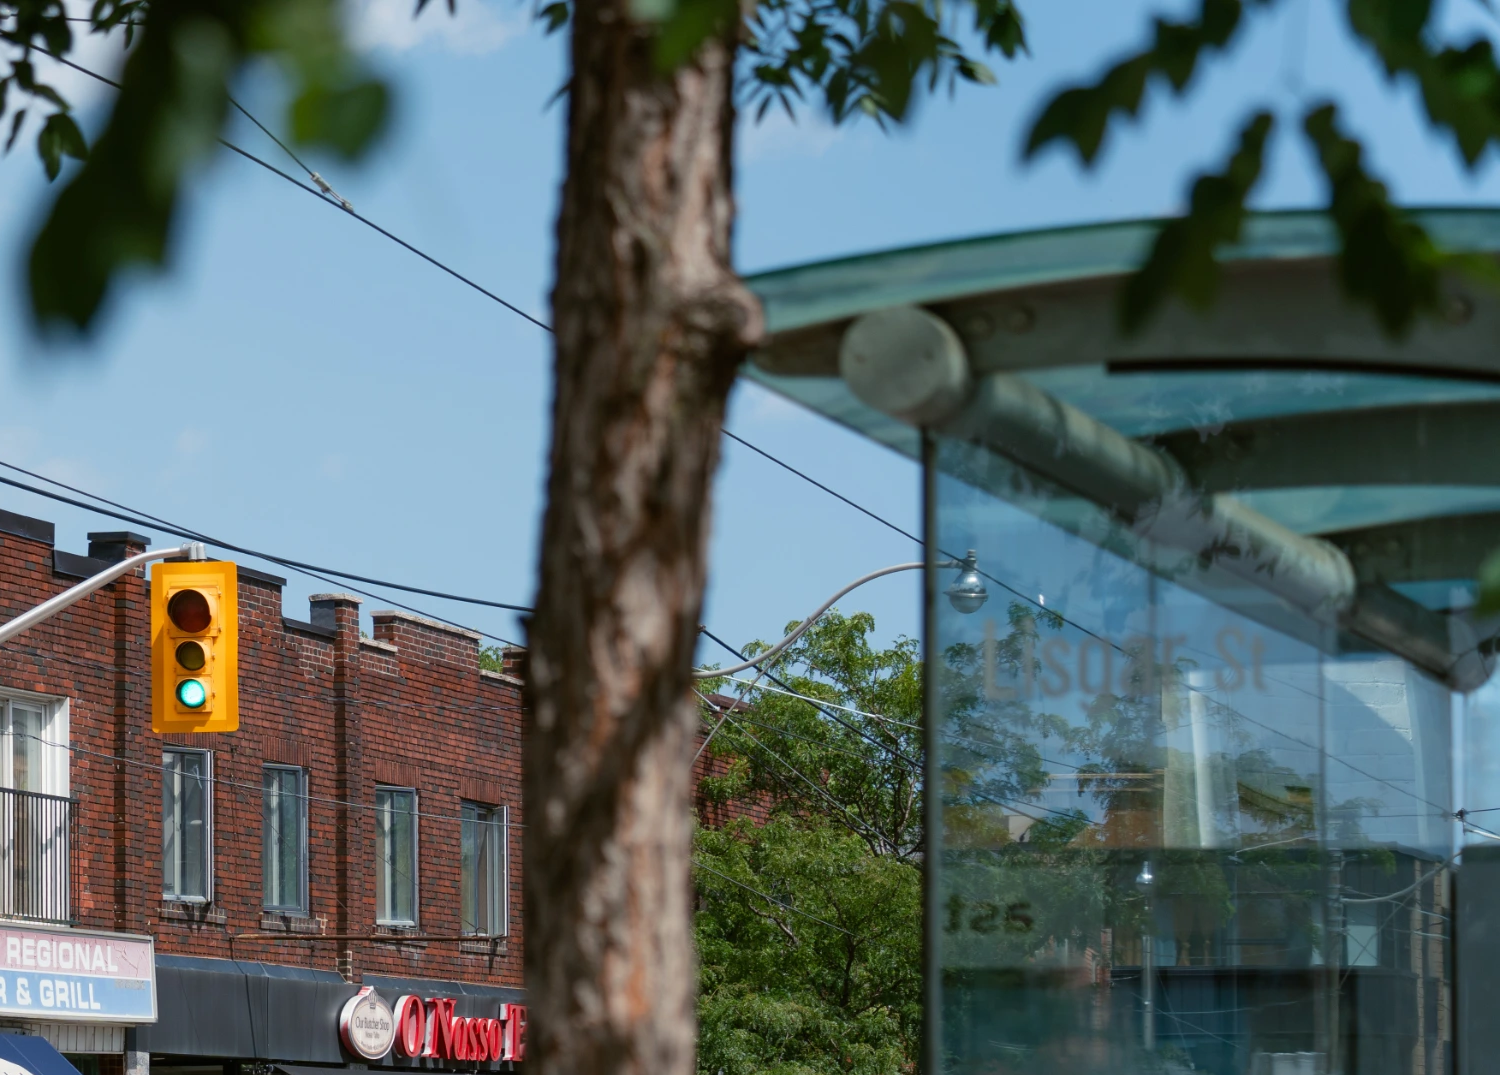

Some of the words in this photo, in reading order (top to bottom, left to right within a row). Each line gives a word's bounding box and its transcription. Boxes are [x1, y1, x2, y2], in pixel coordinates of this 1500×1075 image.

[983, 616, 1187, 714] Lisgar
[1214, 626, 1269, 692] St
[6, 936, 119, 972] REGIONAL
[16, 977, 32, 1006] &
[39, 979, 101, 1010] GRILL
